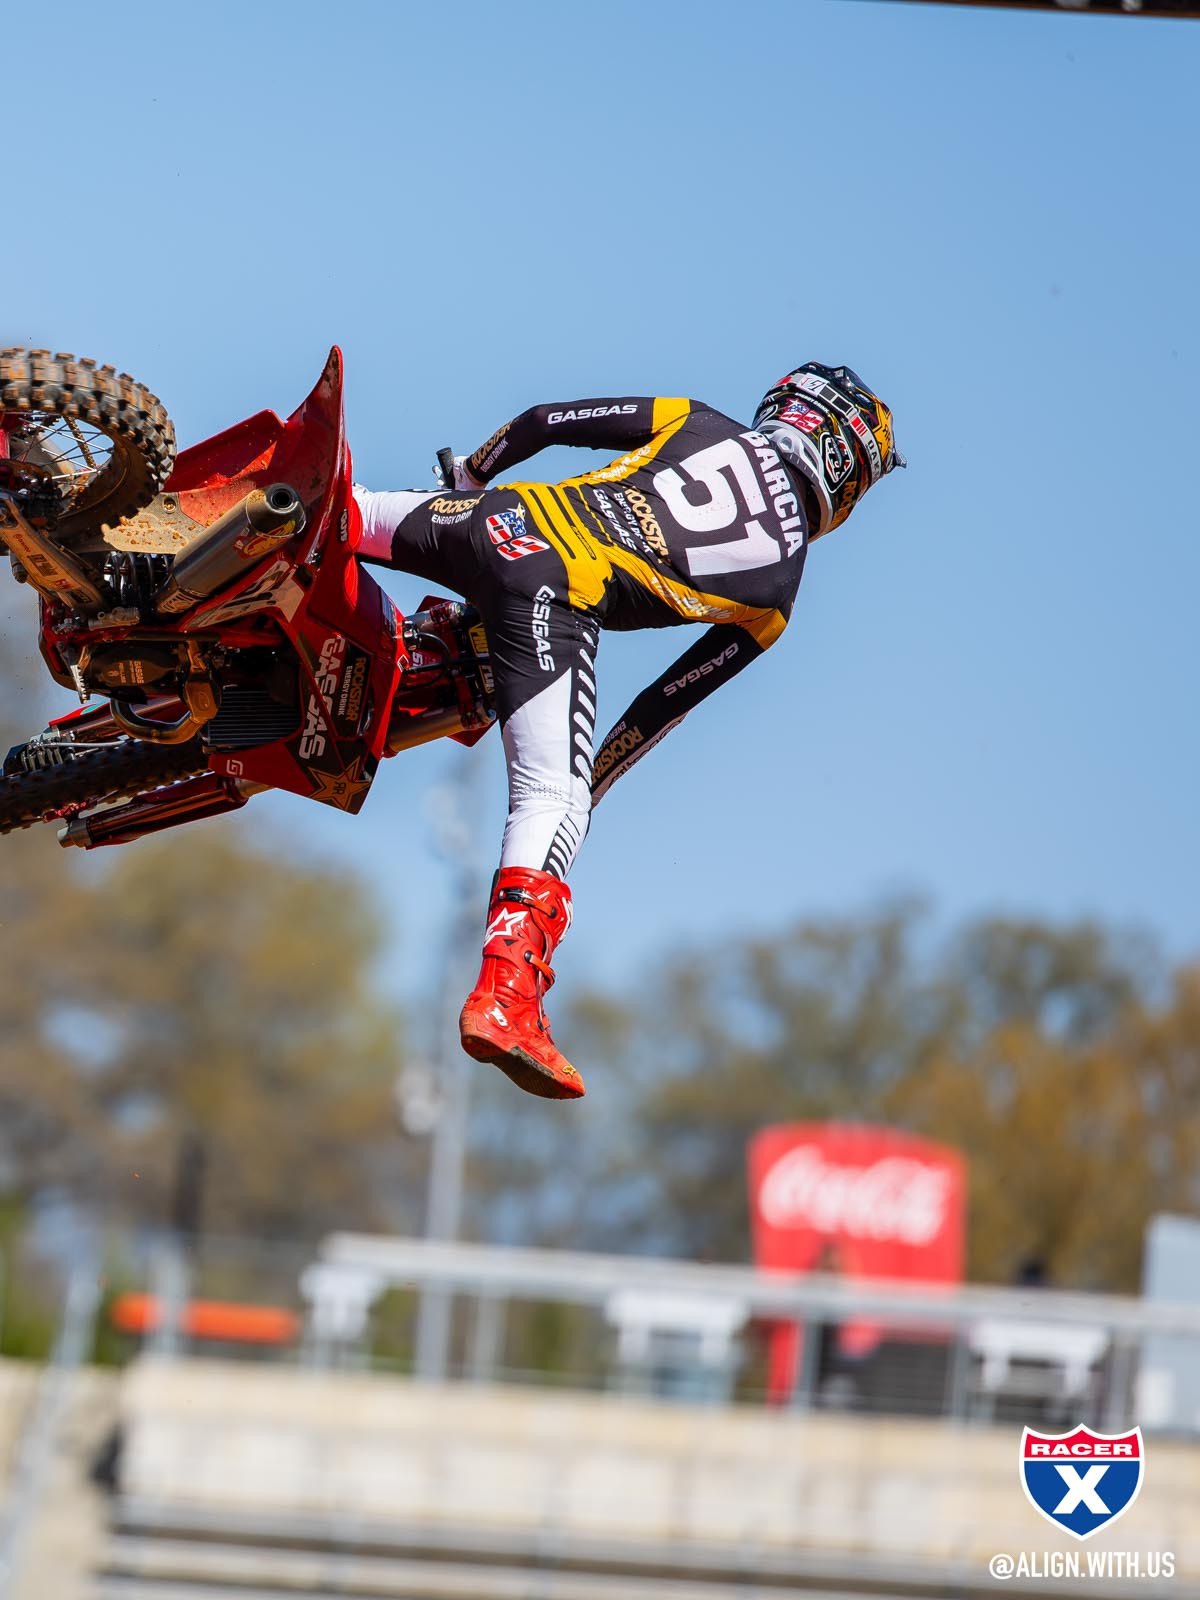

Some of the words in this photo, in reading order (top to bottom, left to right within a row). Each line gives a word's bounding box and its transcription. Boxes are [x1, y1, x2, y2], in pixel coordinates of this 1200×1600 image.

[547, 404, 639, 425] GASGAS
[492, 436, 509, 459] DRINK
[652, 438, 782, 577] 51
[738, 430, 803, 558] BARCIA
[341, 665, 353, 692] ENERGY
[345, 656, 367, 723] ROCKSTAR
[662, 642, 740, 697] GASGAS
[299, 636, 346, 760] GASGAS
[337, 691, 349, 716] DRINK
